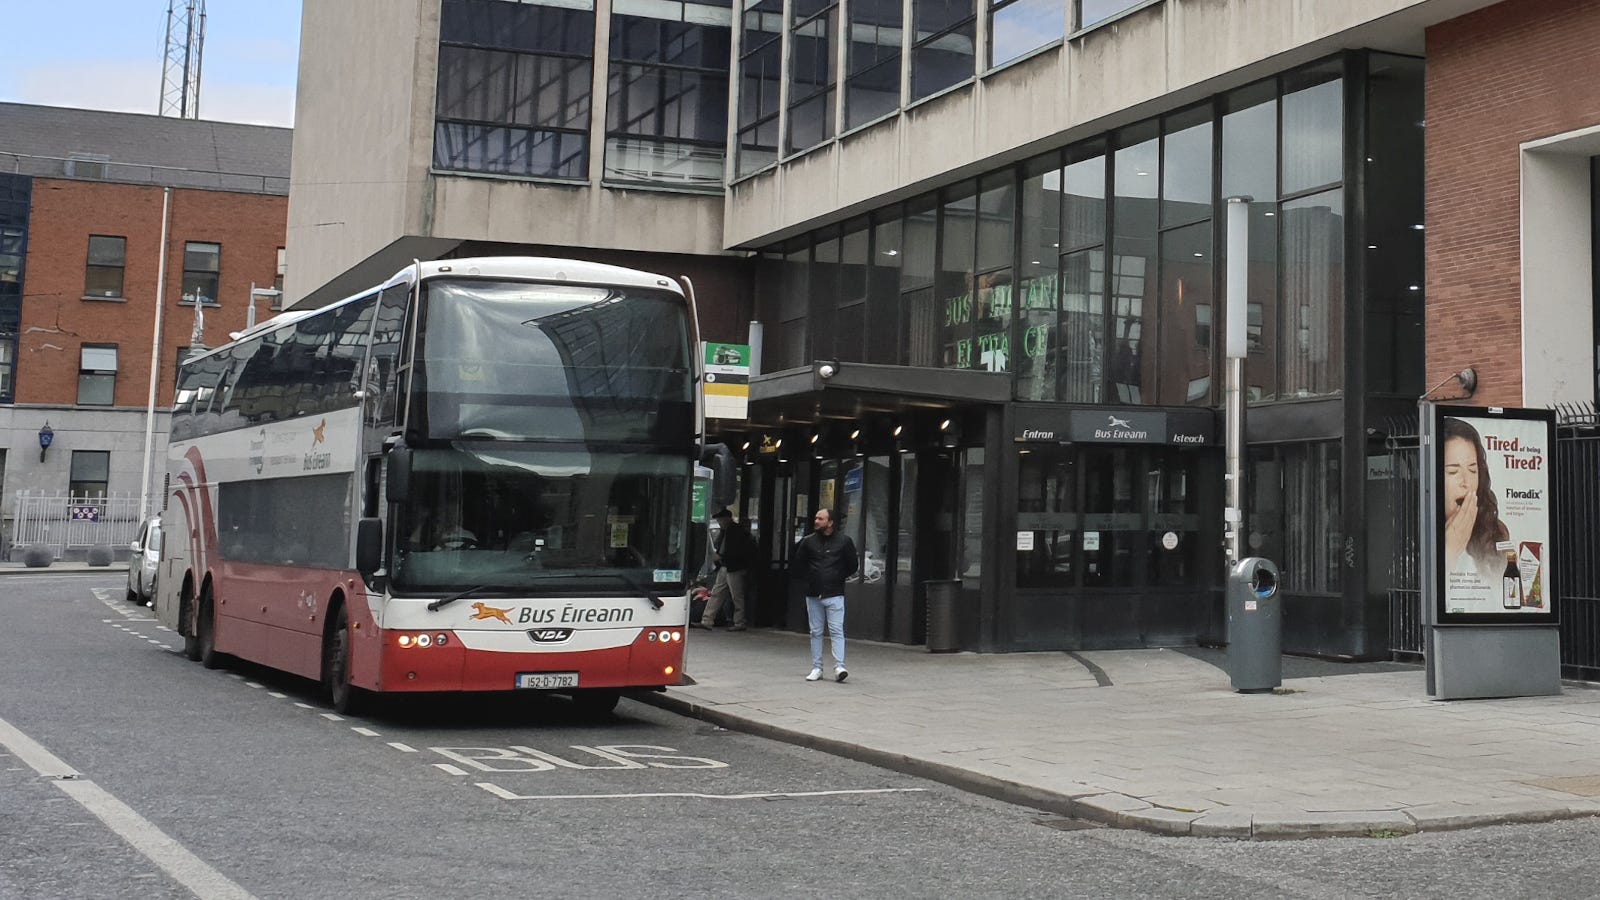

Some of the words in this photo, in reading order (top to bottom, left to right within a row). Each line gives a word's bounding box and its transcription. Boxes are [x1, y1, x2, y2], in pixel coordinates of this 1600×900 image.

[1094, 429, 1112, 439] Bus
[1173, 434, 1205, 443] Isteach
[1485, 436, 1519, 452] Tired
[1526, 446, 1541, 454] being
[1503, 454, 1542, 470] Tired?
[518, 607, 556, 624] Bus
[533, 630, 568, 640] VDL
[428, 744, 730, 772] BUS
